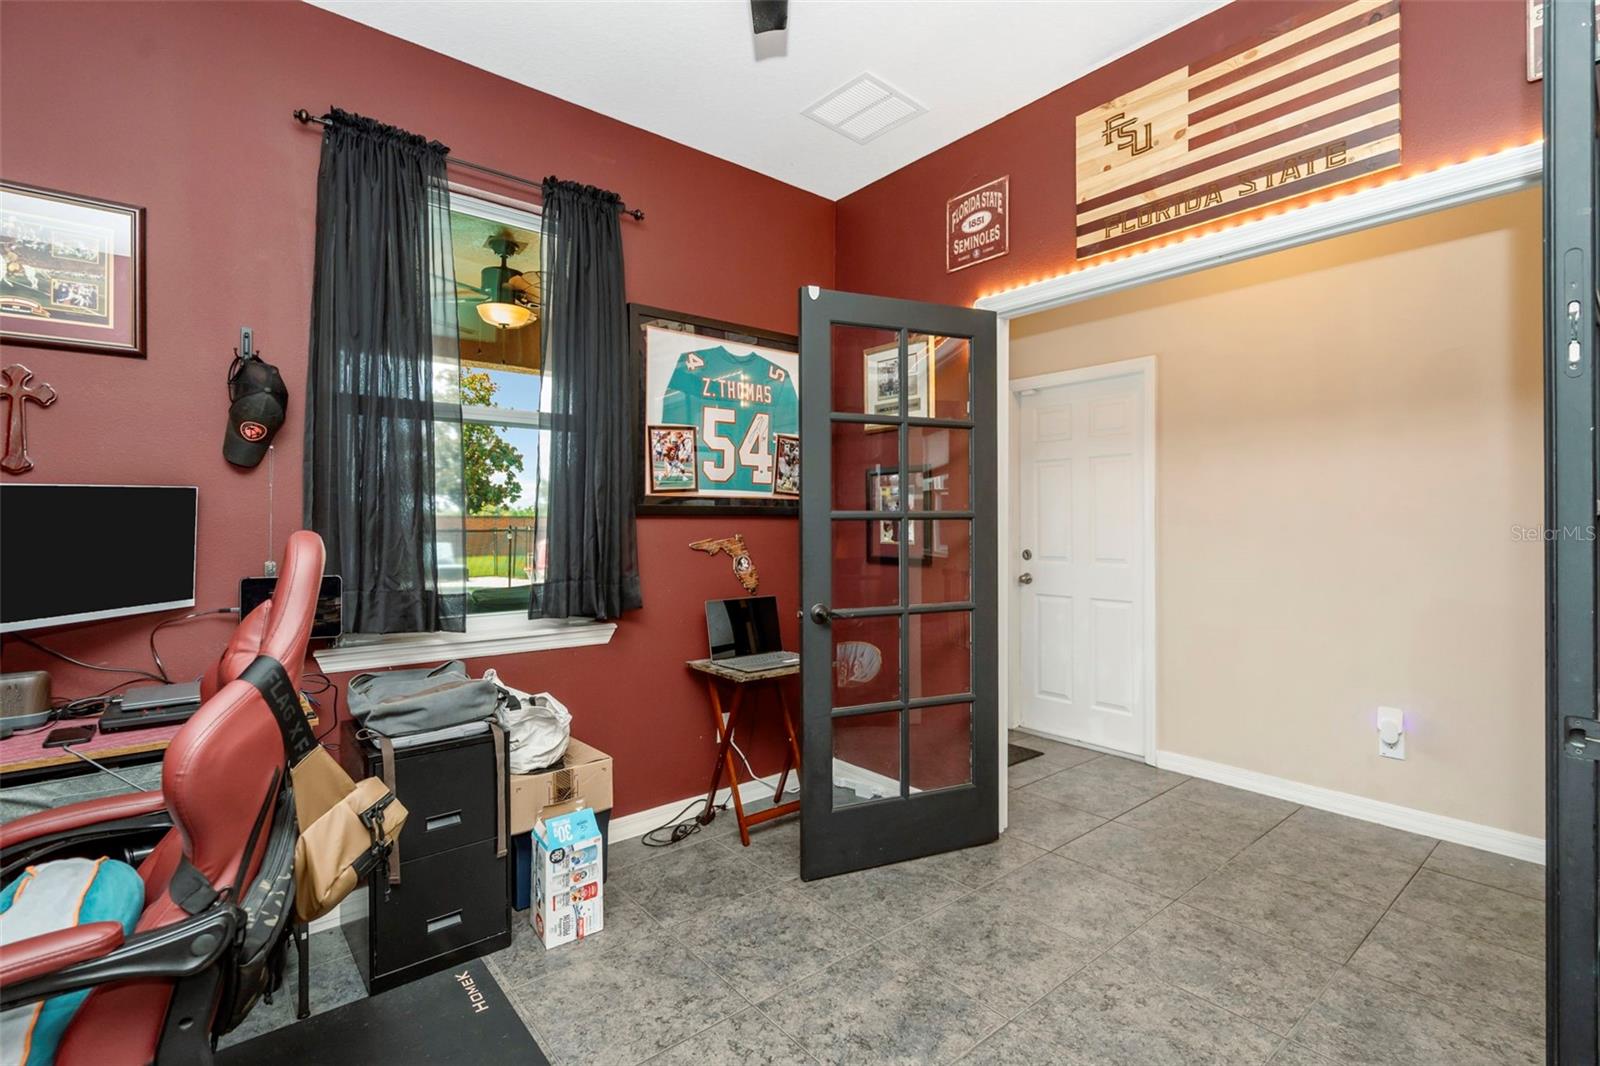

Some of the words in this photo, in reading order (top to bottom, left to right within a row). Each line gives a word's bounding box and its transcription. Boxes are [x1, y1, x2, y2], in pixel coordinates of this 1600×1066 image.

[1102, 112, 1153, 156] FSU
[1104, 184, 1223, 239] FLORIDA
[1238, 140, 1347, 197] STATE
[952, 194, 981, 233] FLORIDA
[981, 192, 1003, 214] STATE
[968, 216, 985, 229] 1851
[953, 224, 1000, 255] SEMINOLES
[686, 353, 704, 371] 4
[720, 379, 772, 404] THOMAS
[702, 406, 773, 484] 54
[269, 669, 296, 721] FLAG
[289, 721, 303, 741] X
[454, 970, 489, 1013] HOMEK
